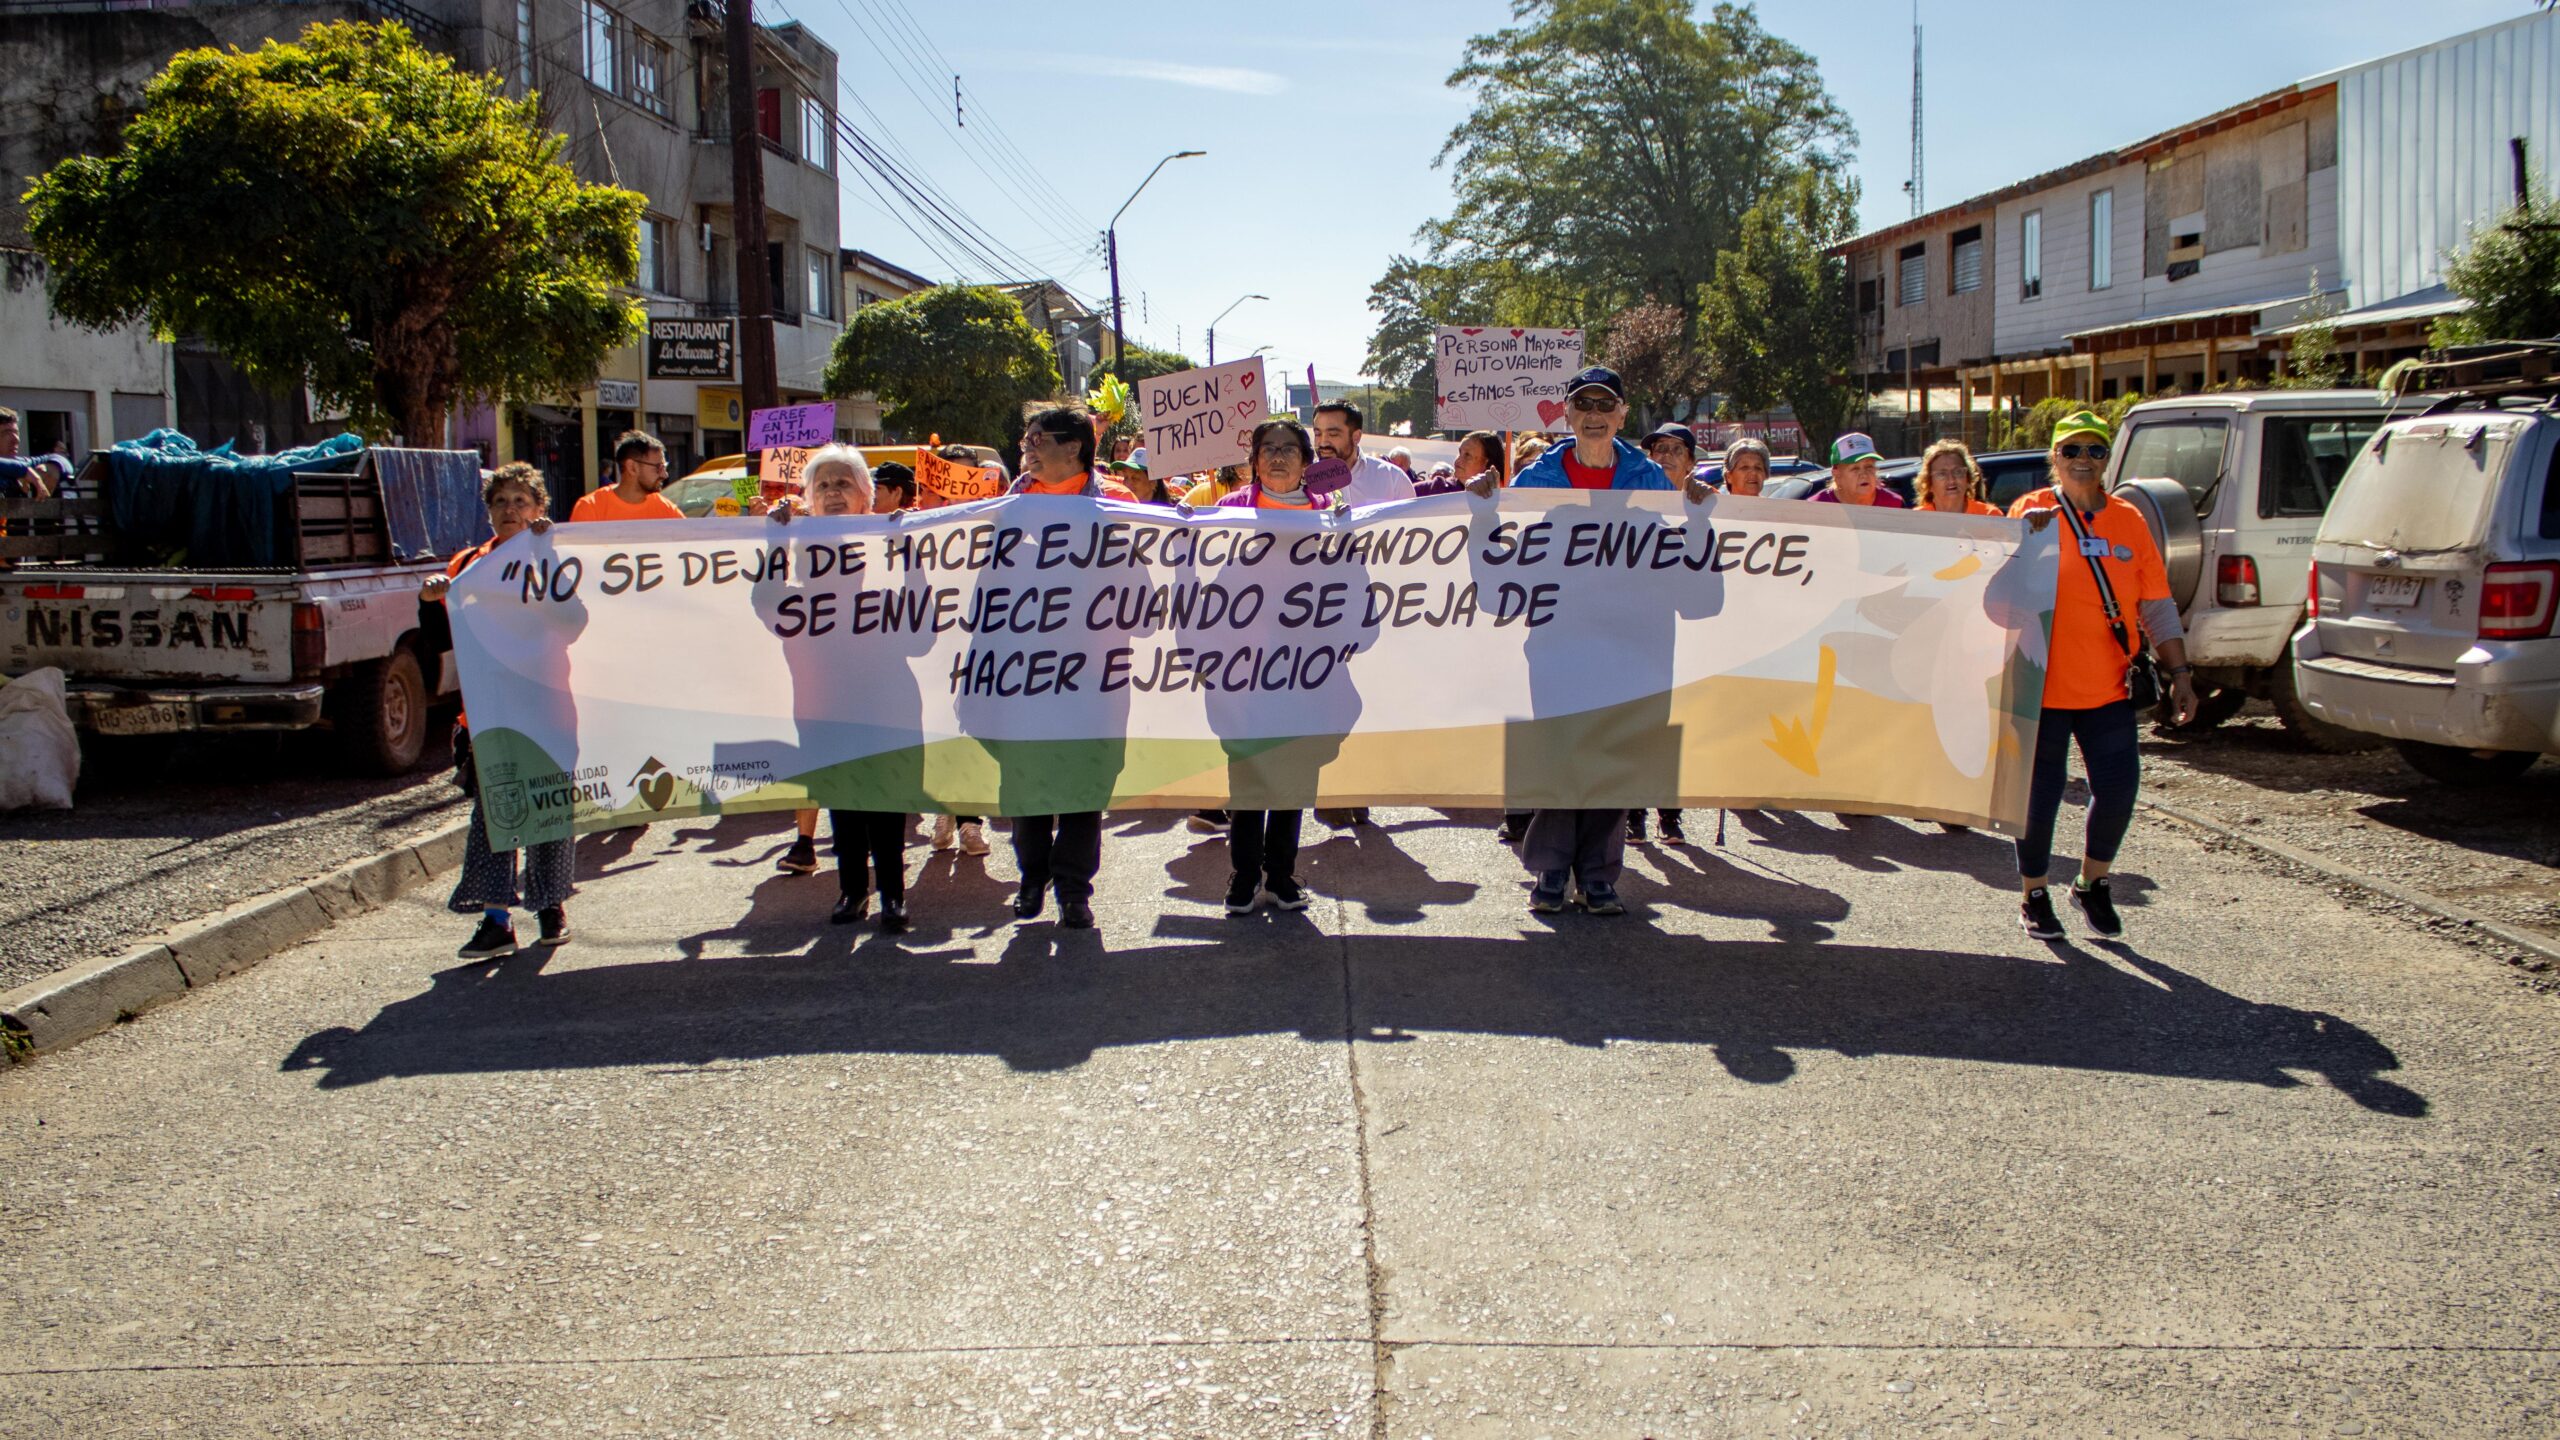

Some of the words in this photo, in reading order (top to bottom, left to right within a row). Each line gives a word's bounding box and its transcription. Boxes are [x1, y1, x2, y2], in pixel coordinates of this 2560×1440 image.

[653, 322, 729, 340] RESTAURANT
[600, 383, 638, 404] RESTAURANT
[1154, 377, 1219, 418] BUEN
[762, 422, 781, 433] EN
[785, 419, 804, 432] TI
[767, 407, 808, 421] CREE
[764, 428, 820, 446] MISMO
[1149, 410, 1224, 455] TRATO
[770, 448, 808, 464] AMOR
[924, 453, 951, 477] AMOR
[967, 469, 978, 480] Y
[925, 468, 980, 496] RESPETO
[600, 552, 663, 596] SE
[683, 546, 789, 587] DEJA
[807, 541, 867, 579] DE
[885, 524, 1023, 572] HACER
[1036, 521, 1276, 570] EJERCICIO
[1289, 525, 1469, 566] CUANDO
[1482, 521, 1553, 566] SE
[1563, 520, 1814, 586] ENVEJECE,
[340, 599, 367, 611] NISSAN
[775, 592, 837, 637] SE
[852, 585, 1072, 635] ENVEJECE
[1085, 581, 1264, 632] CUANDO
[1278, 581, 1349, 629] SE
[1361, 581, 1479, 628] DEJA
[1493, 582, 1560, 628] DE
[26, 609, 248, 649] NISSAN
[950, 648, 1087, 696] HACER
[529, 765, 609, 789] MUNICIPALIDAD
[686, 760, 770, 776] DEPARTAMENTO
[532, 781, 612, 811] VICTORIA
[685, 776, 728, 797] Adulto
[734, 773, 777, 793] Mayor
[534, 814, 565, 834] Juntos
